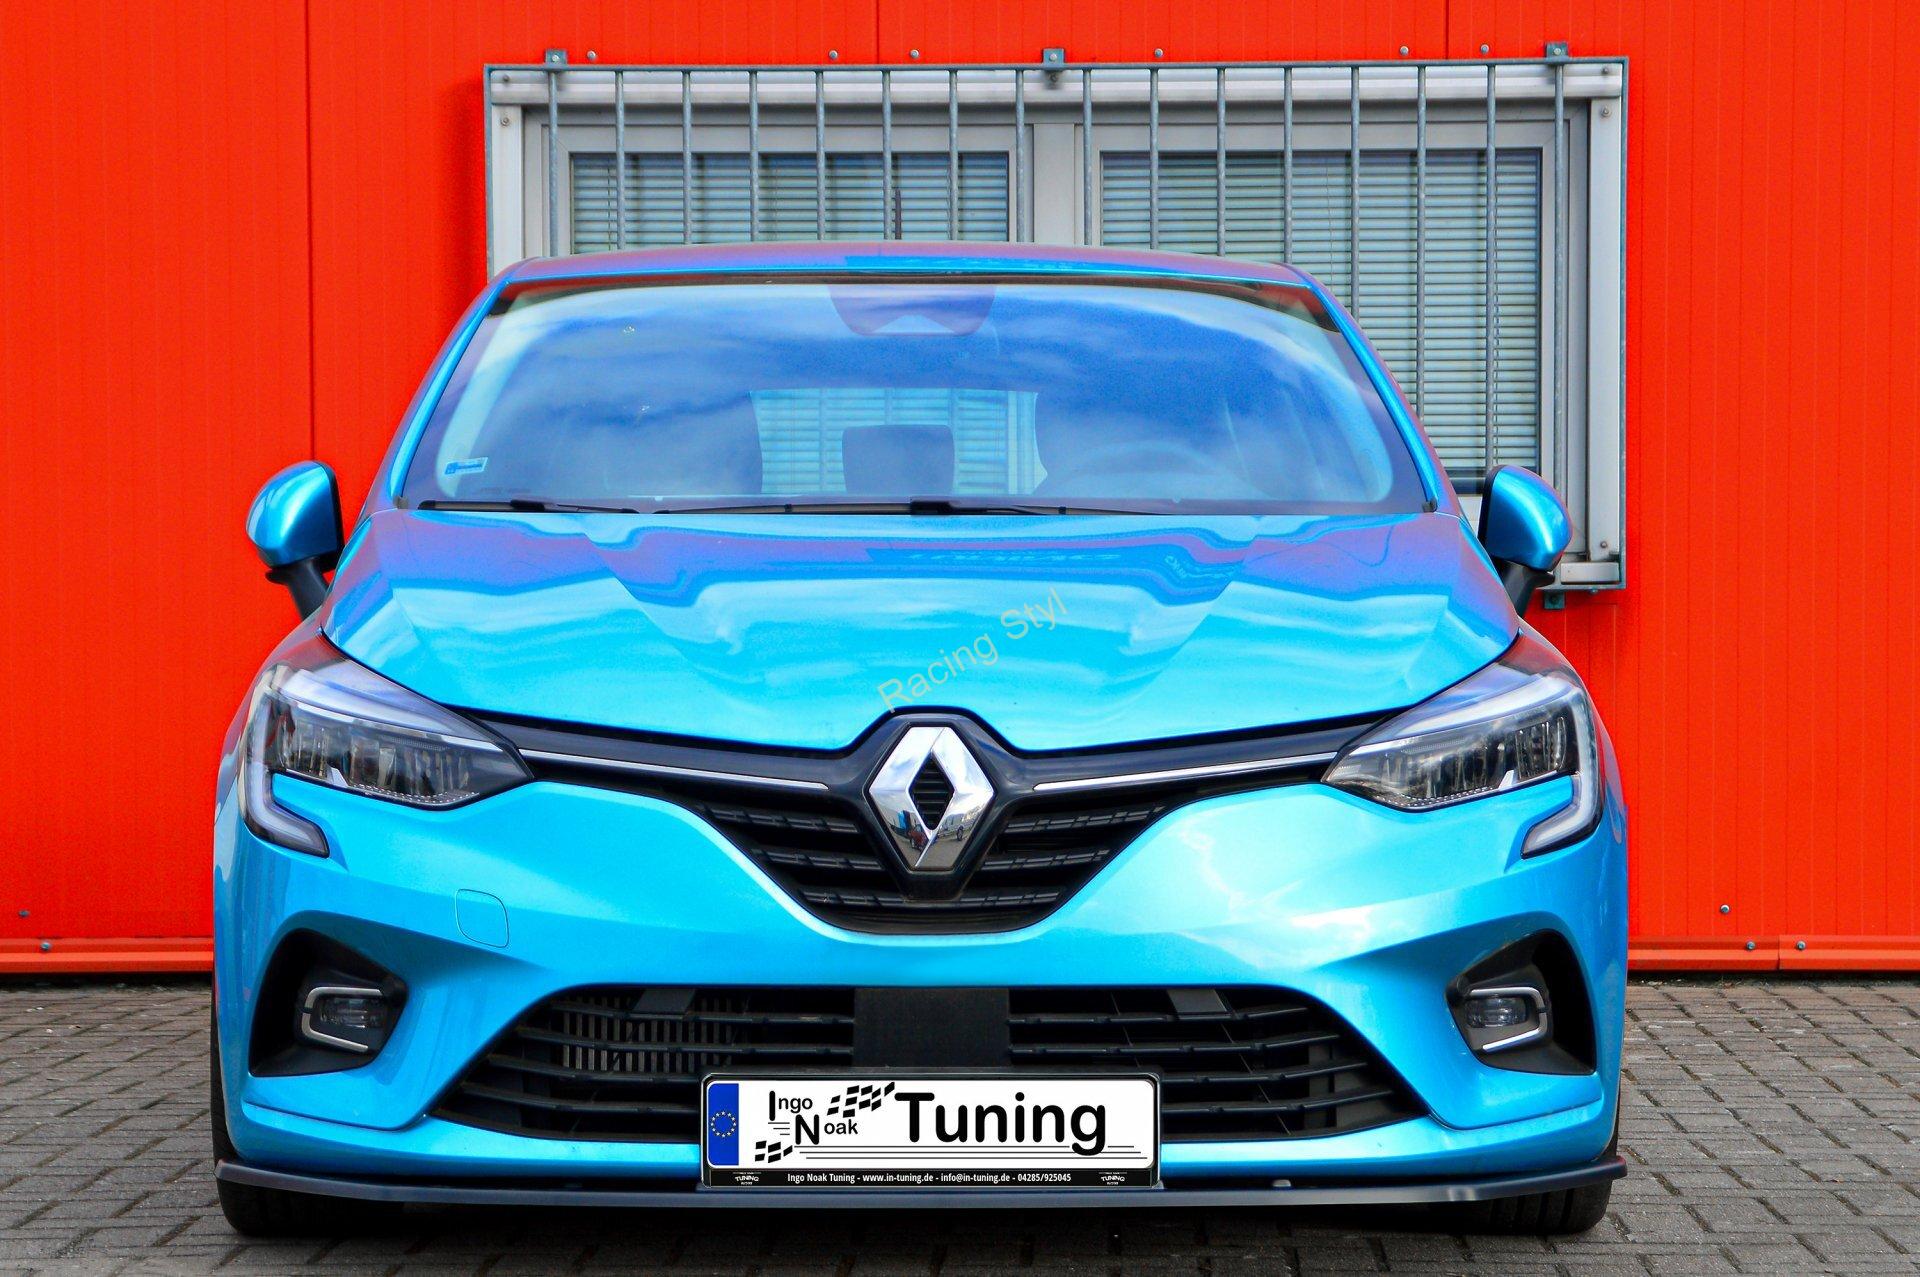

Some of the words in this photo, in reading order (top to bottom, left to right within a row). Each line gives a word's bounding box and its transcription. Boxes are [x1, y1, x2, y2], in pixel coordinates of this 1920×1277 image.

[769, 1090, 814, 1122] Ingo
[795, 1114, 859, 1145] Noak
[894, 1091, 1106, 1157] Tuning
[787, 1173, 805, 1184] Ingo
[806, 1172, 828, 1182] Noak
[829, 1173, 856, 1184] Tuning
[862, 1172, 934, 1184] www.in-tuning.de
[940, 1172, 1011, 1184] info@in-tuning.de
[1017, 1173, 1072, 1183] 04285/925045
